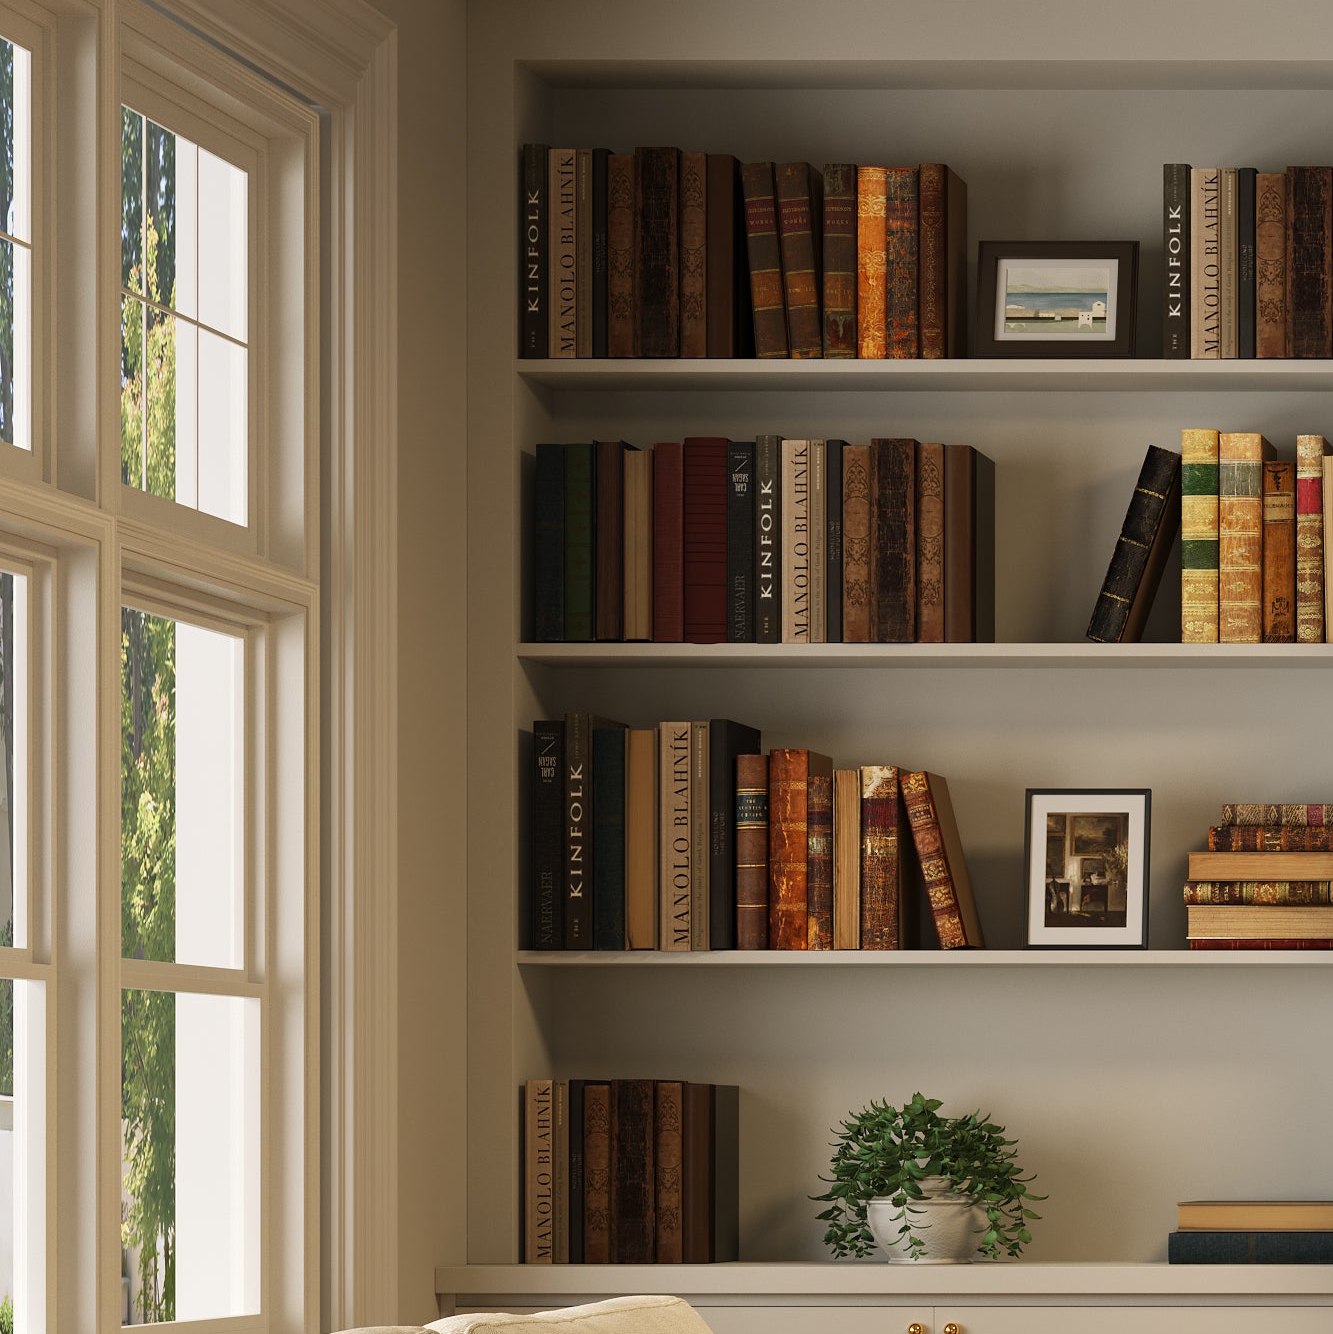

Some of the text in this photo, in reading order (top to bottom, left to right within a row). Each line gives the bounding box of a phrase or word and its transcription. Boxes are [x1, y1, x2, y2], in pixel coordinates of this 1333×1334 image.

[527, 188, 540, 314] KINFOLK
[556, 155, 576, 353] MANOLO BLAHNÍK
[1168, 204, 1181, 317] KINFOLK
[1201, 173, 1220, 353] MANOLO BLAHNÍK
[732, 473, 749, 483] SAGAN
[734, 482, 747, 492] CARL
[760, 479, 772, 599] KINFOLK
[790, 447, 809, 637] MANOLO BLAHNÍK
[538, 756, 557, 767] SAGAN
[540, 766, 555, 777] CARL
[569, 763, 583, 898] KINFOLK
[669, 729, 689, 945] MANOLO BLAHNÍK
[534, 1085, 552, 1259] MANOLO BLAHNÍK
